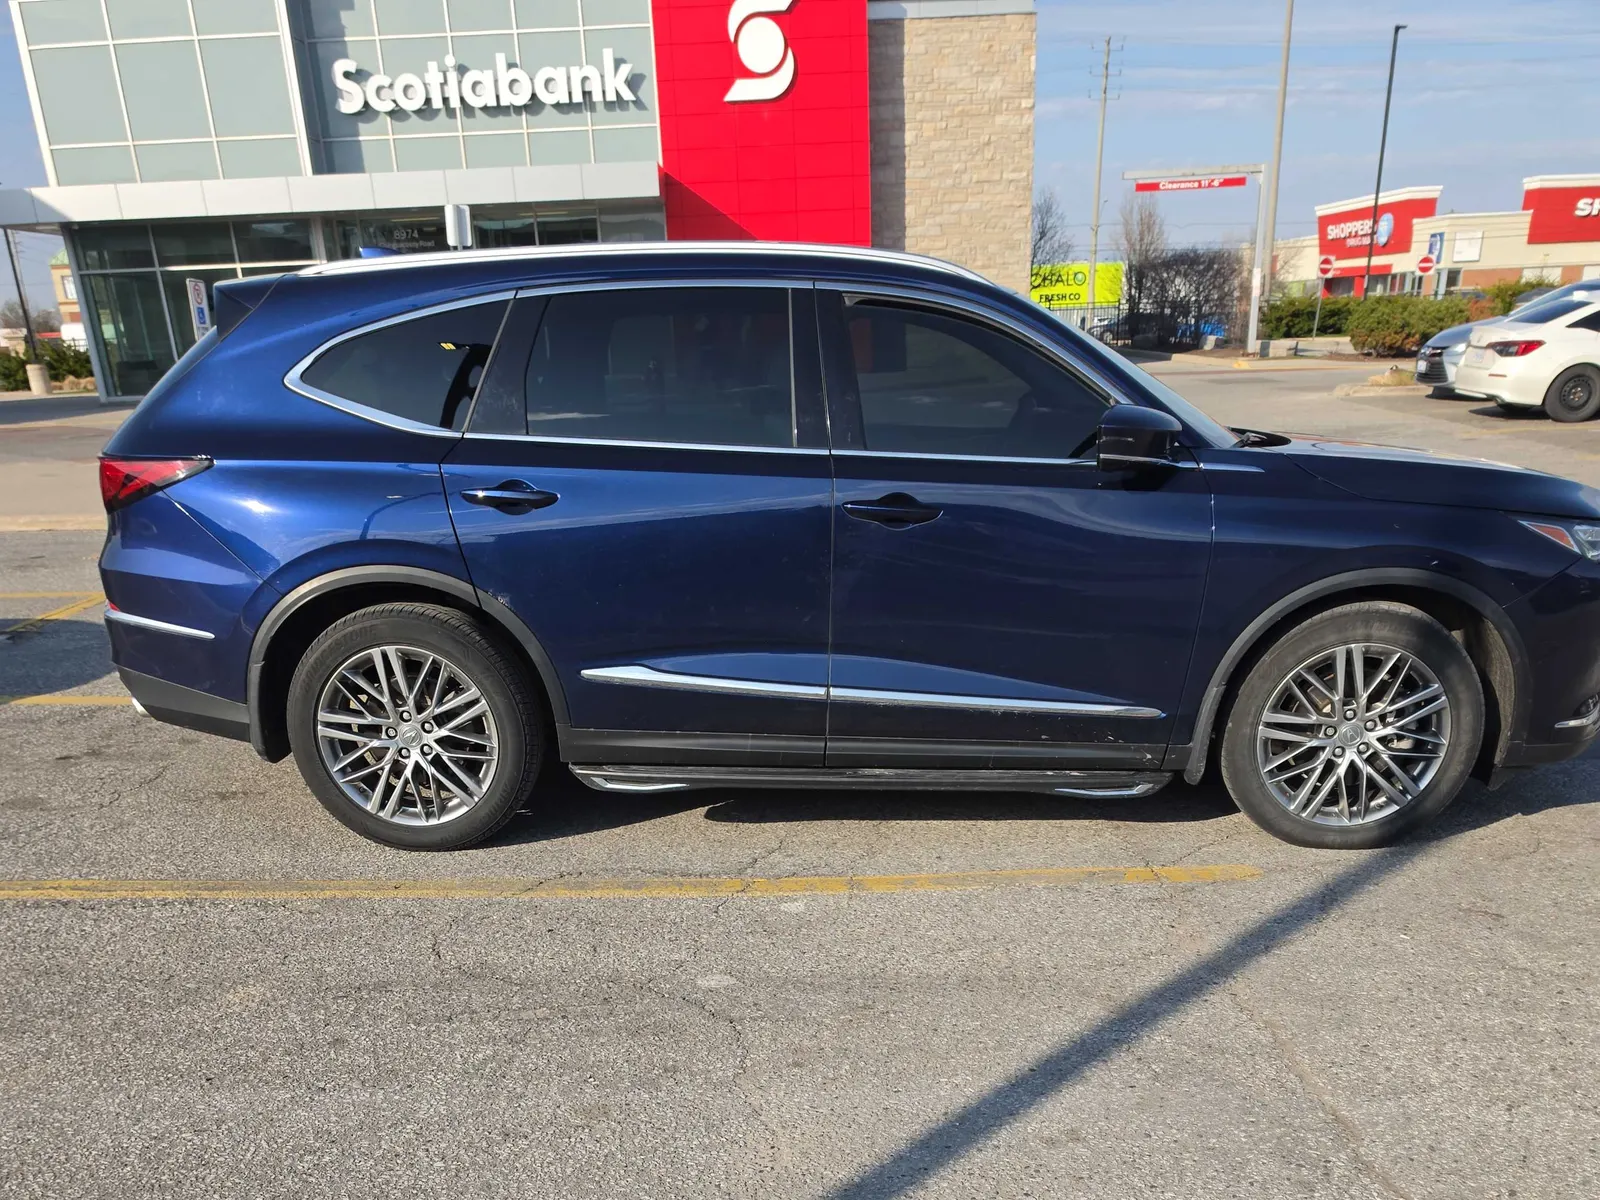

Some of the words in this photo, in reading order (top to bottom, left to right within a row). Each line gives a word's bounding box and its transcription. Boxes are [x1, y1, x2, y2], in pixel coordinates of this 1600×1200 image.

[332, 47, 637, 114] Scotiabank
[1159, 180, 1199, 190] Clearance
[394, 229, 419, 240] 8974
[1040, 292, 1067, 302] FRESH
[1068, 292, 1081, 301] CO
